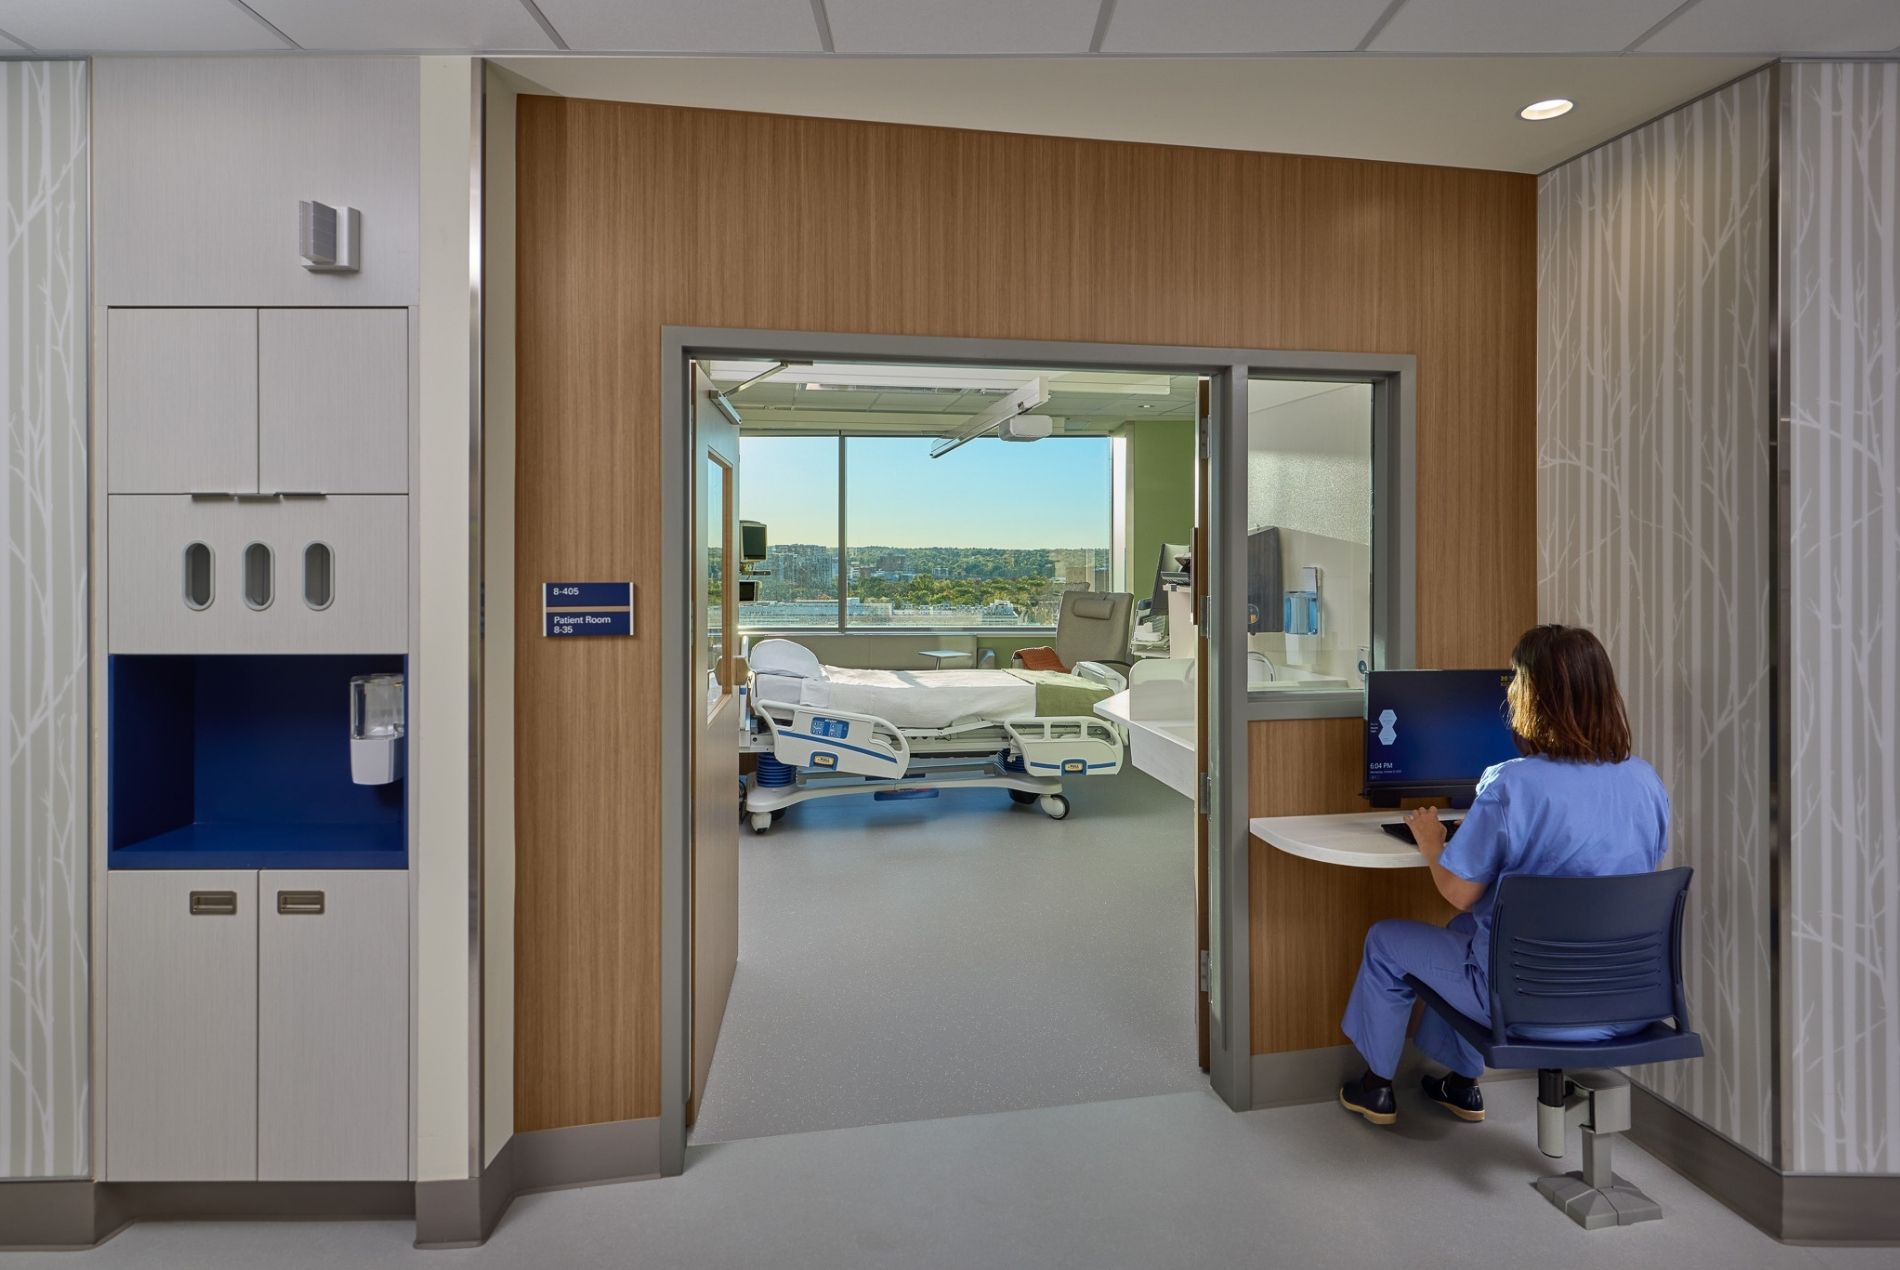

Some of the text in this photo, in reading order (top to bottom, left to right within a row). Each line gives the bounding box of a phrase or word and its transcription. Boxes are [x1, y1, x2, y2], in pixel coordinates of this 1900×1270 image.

[553, 587, 580, 596] 8-405
[554, 615, 612, 624] Patient Room
[553, 625, 574, 634] 8-35
